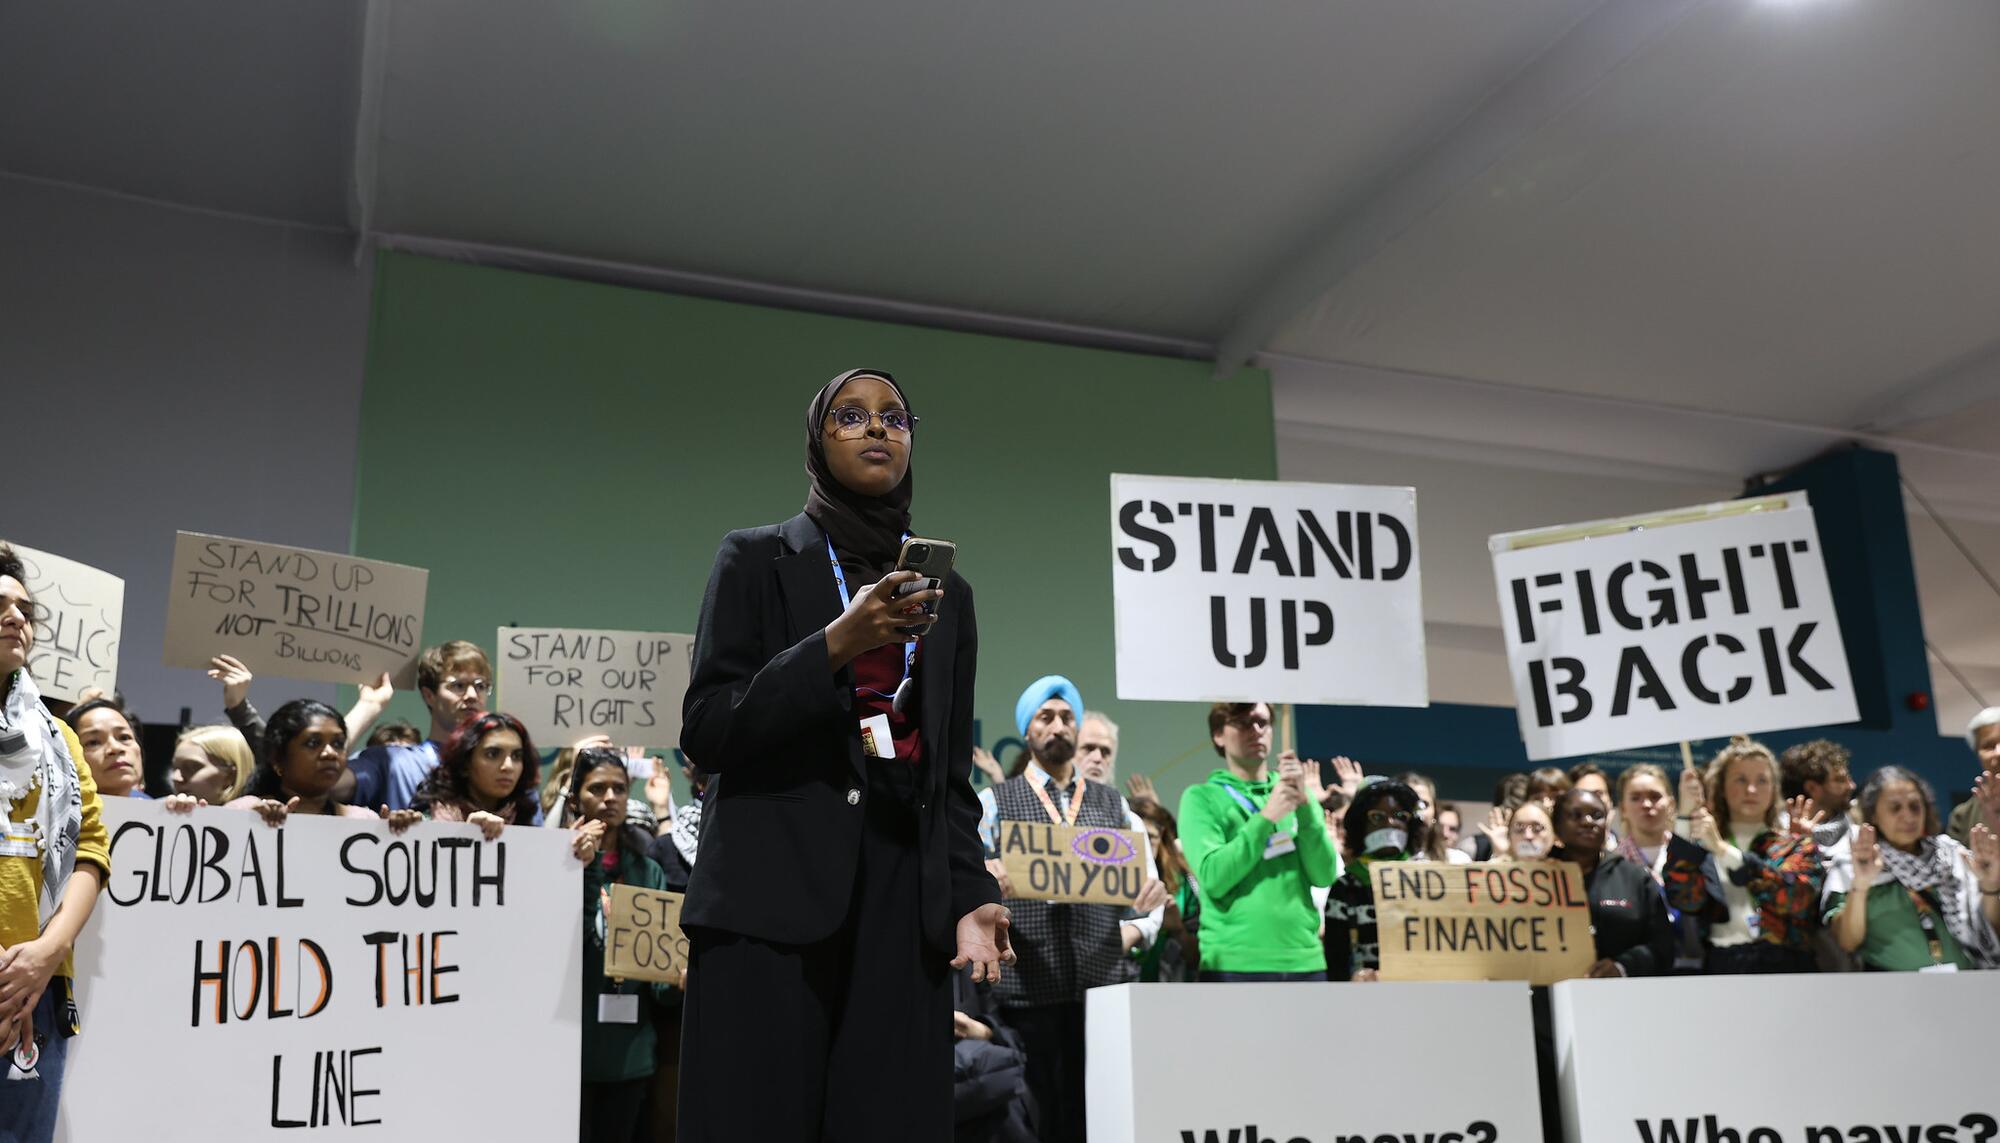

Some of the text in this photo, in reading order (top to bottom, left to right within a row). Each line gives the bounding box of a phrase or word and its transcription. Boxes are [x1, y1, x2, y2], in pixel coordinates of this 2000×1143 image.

[199, 543, 374, 592] STAND UP
[1117, 500, 1412, 581] STAND
[187, 570, 418, 648] FOR TRILLIONS
[1511, 540, 1809, 643] FIGHT
[215, 612, 276, 637] NOT
[508, 633, 616, 663] STAND
[637, 639, 672, 667] UP
[1210, 596, 1334, 670] UP
[524, 665, 657, 692] FOR OUR
[1528, 622, 1835, 727] BACK
[553, 694, 656, 729] RIGHTS
[107, 821, 506, 907] GLOBAL SOUTH
[1006, 822, 1062, 857] ALL
[1029, 858, 1142, 900] ON YOU
[1379, 868, 1590, 910] END FOSSIL
[191, 930, 460, 1027] HOLD THE
[271, 1047, 382, 1128] LINE
